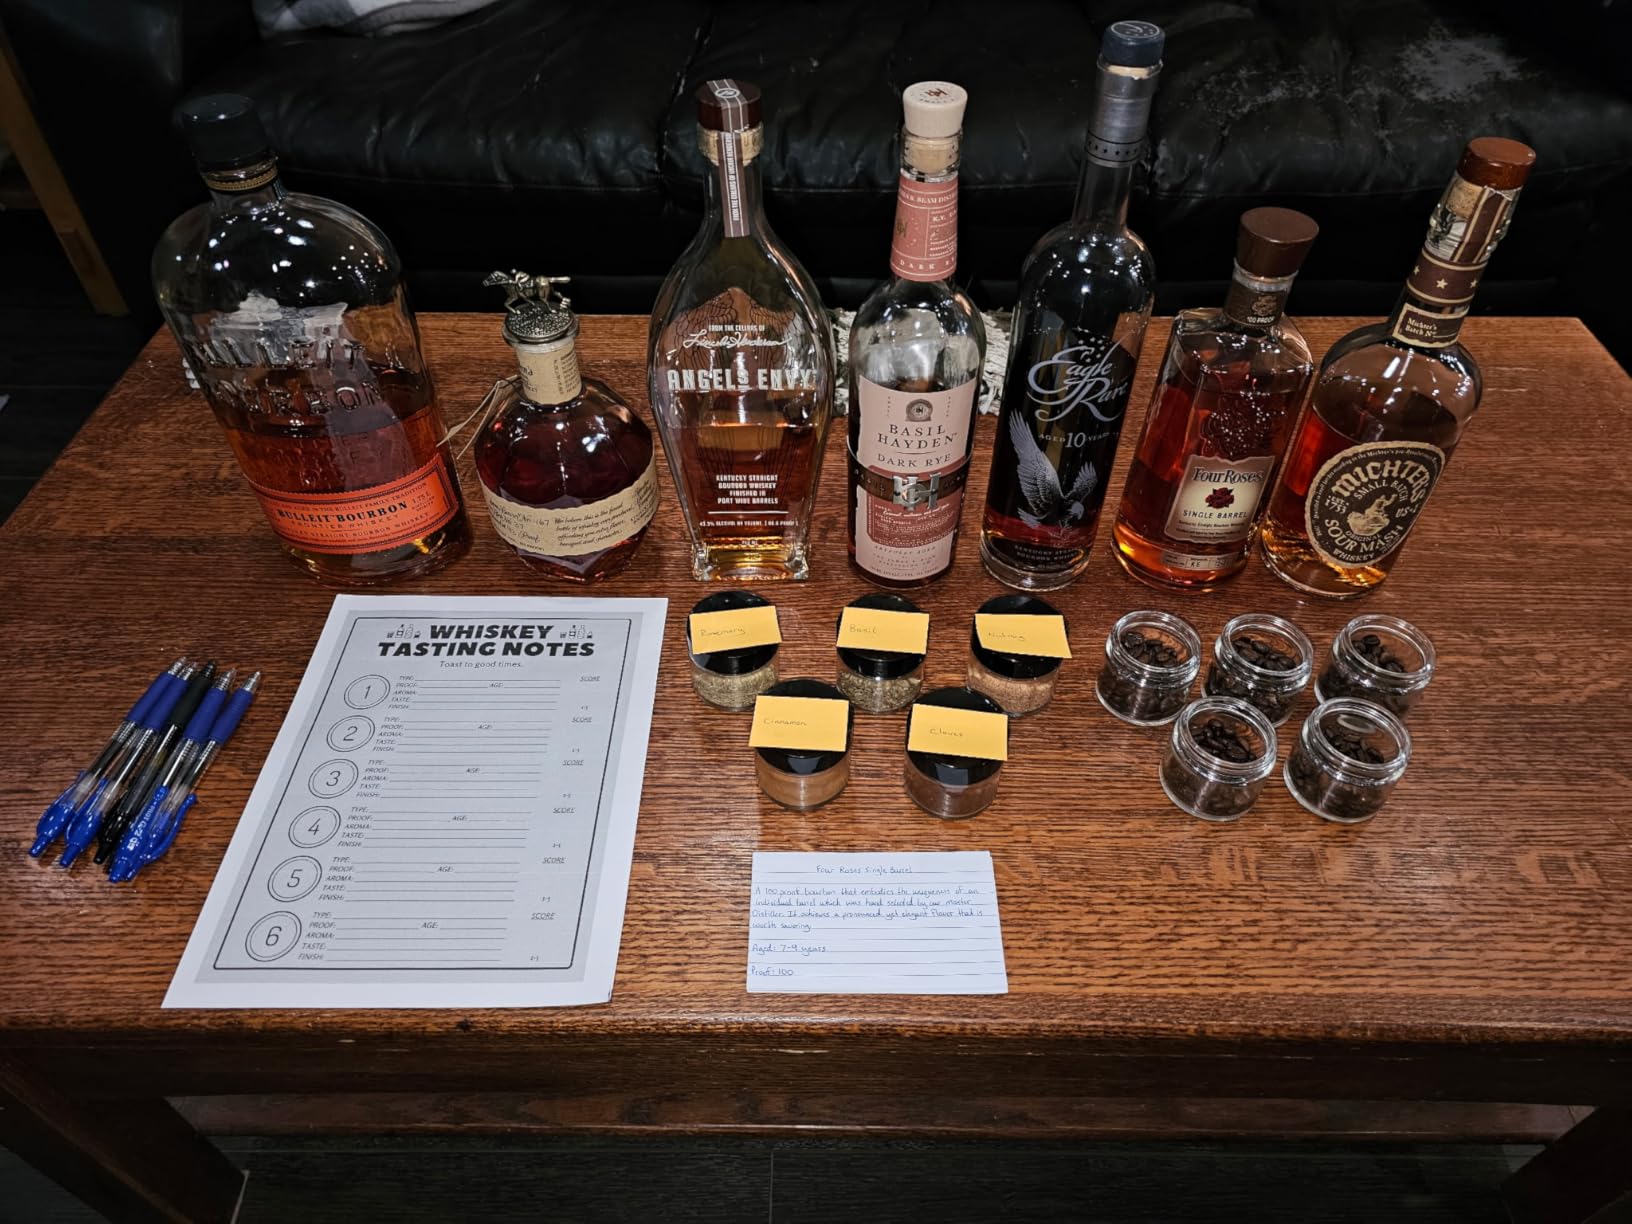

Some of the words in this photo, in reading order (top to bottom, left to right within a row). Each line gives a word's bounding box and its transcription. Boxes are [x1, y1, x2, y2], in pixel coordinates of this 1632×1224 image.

[1405, 324, 1424, 335] Batch
[1407, 317, 1437, 330] Michter's
[757, 367, 812, 391] ENVY
[889, 423, 946, 437] BASIL
[878, 432, 955, 449] HAYDEN
[1039, 433, 1065, 443] AGED
[1065, 431, 1086, 448] 10
[877, 453, 917, 467] DARK
[925, 453, 951, 467] RYE
[715, 474, 747, 482] KENTUCKY
[748, 474, 778, 482] STRAIGHT
[1193, 466, 1225, 481] Four
[1223, 469, 1265, 484] Roses
[1330, 459, 1431, 504] MICHTER'S
[392, 482, 427, 501] TRADITION
[1353, 480, 1388, 500] SMALL
[1390, 480, 1409, 502] BATCH
[717, 497, 733, 505] PORT
[752, 497, 779, 505] BARRELS
[276, 508, 331, 523] BULLEIT
[336, 500, 408, 522] BOURBON
[1183, 509, 1214, 519] SINGLE
[1216, 511, 1248, 519] BARREL
[1324, 519, 1358, 552] SOUR
[1360, 525, 1404, 553] MASH
[1332, 548, 1376, 561] WHISKEY
[430, 625, 554, 639] WHISKEY
[700, 625, 746, 637] Rosemary
[849, 623, 877, 634] Basil
[378, 642, 496, 656] TASTING
[501, 642, 595, 656] NOTES
[440, 660, 463, 668] Toast
[464, 660, 473, 668] to
[474, 660, 496, 669] good
[364, 684, 371, 699] 1
[763, 717, 807, 726] Cinnamon
[343, 726, 358, 741] 2
[929, 727, 963, 737] Cloves
[326, 770, 341, 787] 3
[307, 818, 321, 836] 4
[542, 856, 566, 865] SCORE
[816, 864, 834, 874] Four
[839, 865, 861, 874] Roses
[865, 865, 886, 876] Single
[287, 868, 303, 888] 5
[755, 886, 761, 895] A
[765, 887, 777, 895] 100
[841, 887, 859, 895] that
[530, 912, 556, 921] SCORE
[787, 910, 797, 918] It
[885, 909, 898, 920] yet
[958, 909, 974, 917] that
[265, 926, 282, 947] 6
[752, 943, 776, 955] Aged:
[778, 967, 794, 976] 100
